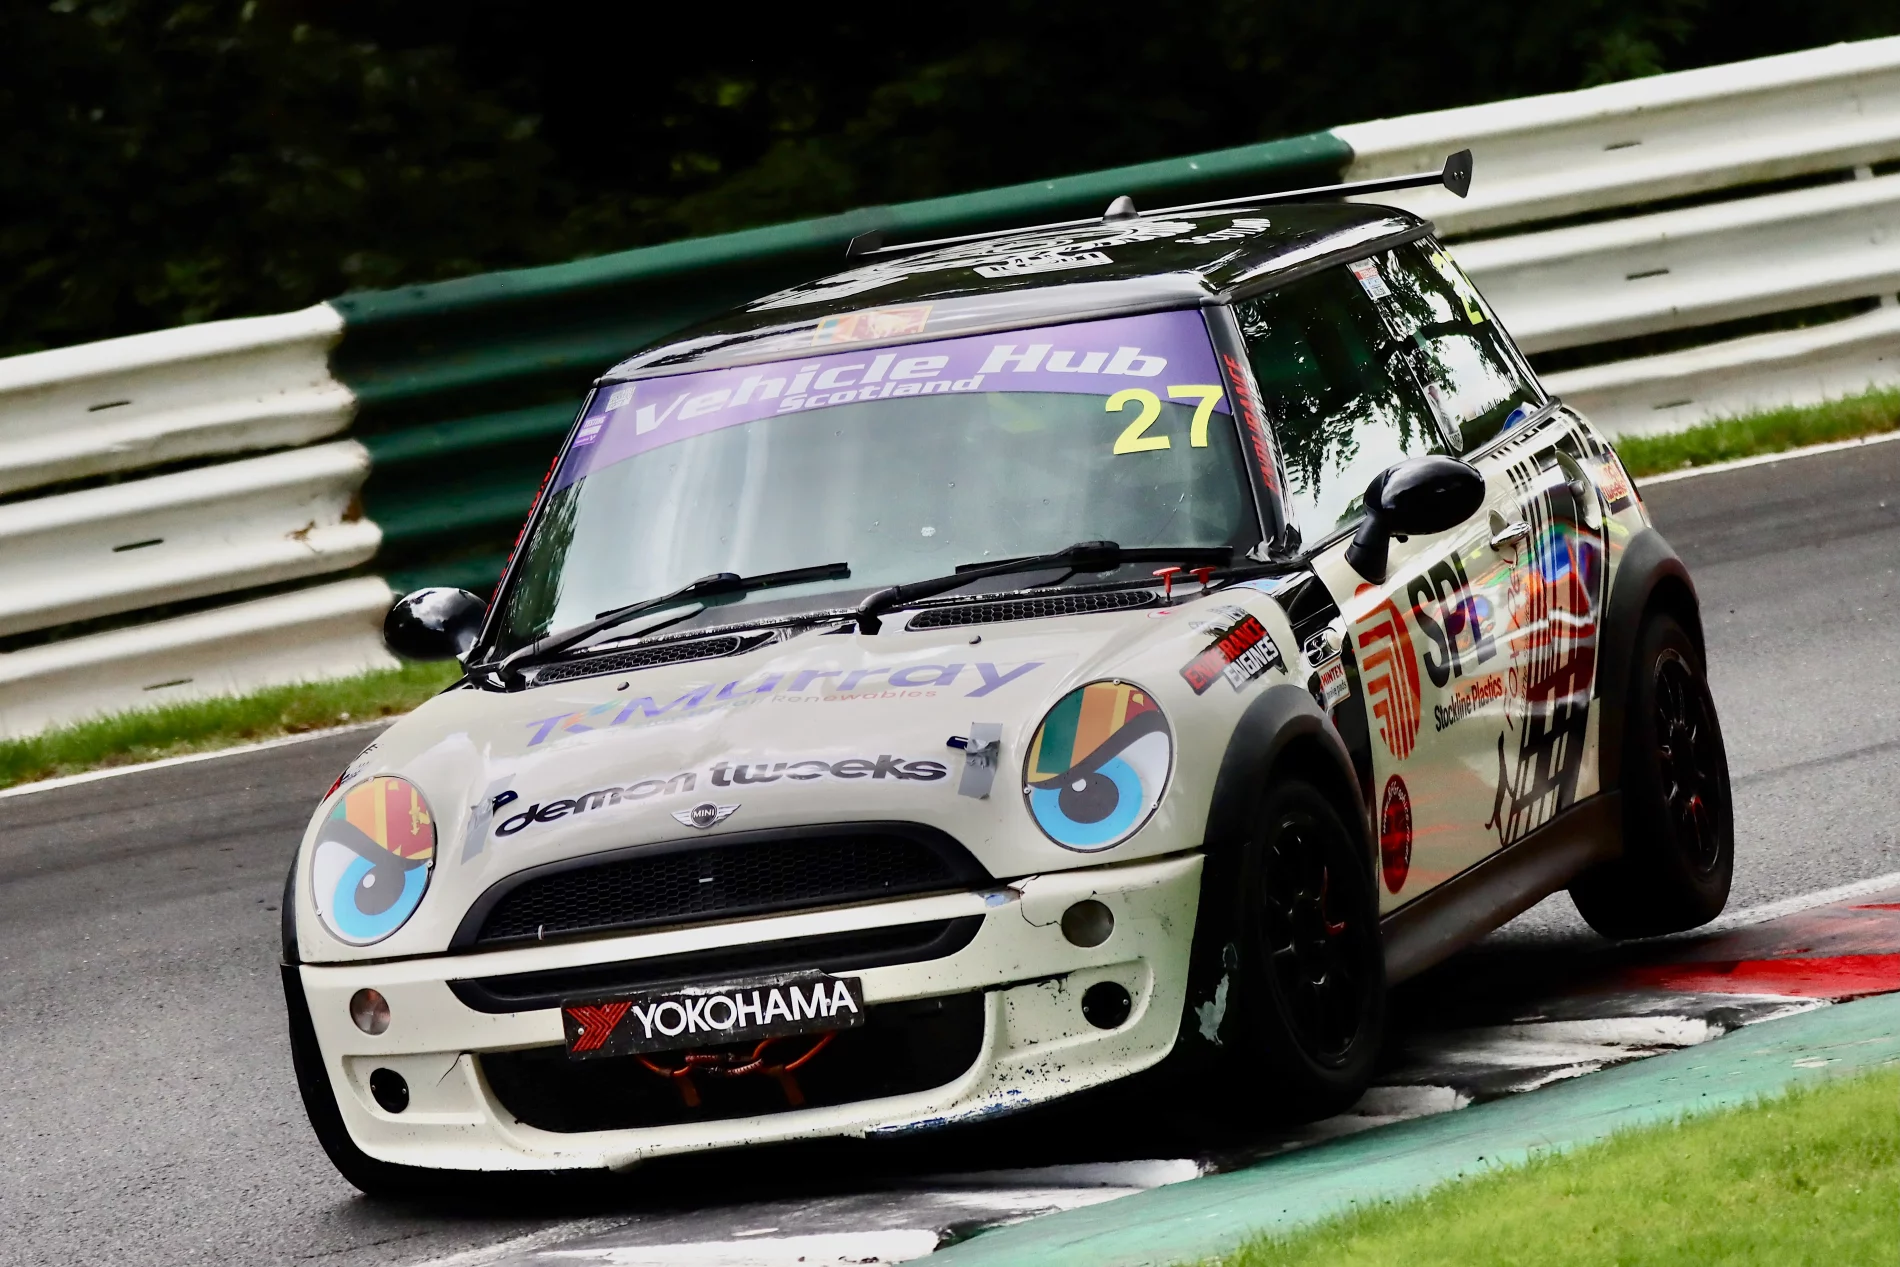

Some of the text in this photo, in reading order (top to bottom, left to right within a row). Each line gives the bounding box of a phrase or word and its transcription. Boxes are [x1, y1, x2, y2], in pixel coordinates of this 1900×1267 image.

[635, 353, 950, 436] Vehicle
[977, 343, 1168, 378] Hub
[776, 374, 985, 414] Scotland
[1104, 385, 1224, 455] 27
[1222, 353, 1280, 495] ENDURANCE
[1183, 616, 1269, 690] ENDURANCE
[1224, 633, 1280, 689] ENGINES
[1320, 664, 1344, 687] MINTEX
[609, 662, 1046, 726] Murray
[771, 688, 938, 704] Renewables
[1336, 678, 1347, 697] pads
[1434, 674, 1503, 732] Stockline Plastics
[494, 754, 948, 839] demon tweeks
[693, 809, 715, 819] MINI
[632, 980, 859, 1039] YOKOHAMA
